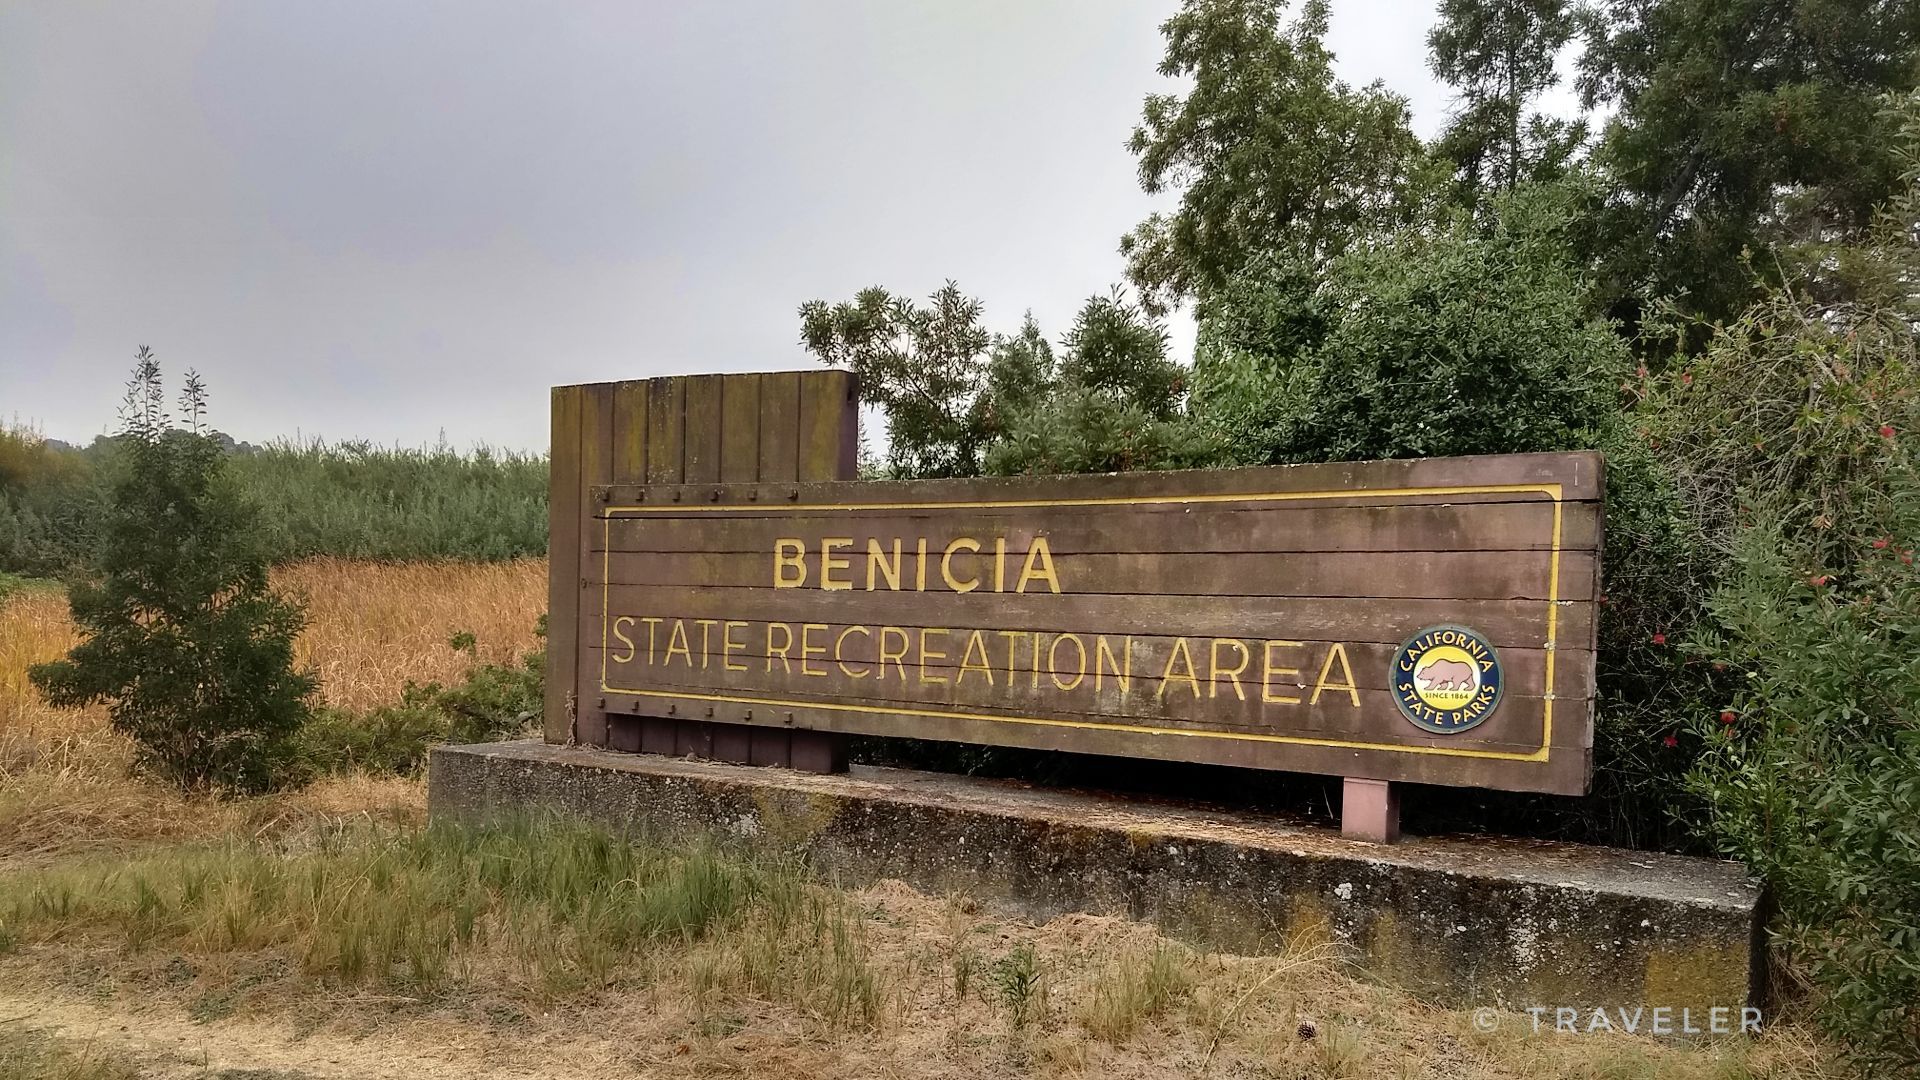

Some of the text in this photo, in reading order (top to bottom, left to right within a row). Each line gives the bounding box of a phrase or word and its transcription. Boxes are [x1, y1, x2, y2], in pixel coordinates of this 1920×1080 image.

[773, 537, 1061, 594] BENICIA
[611, 616, 1361, 707] STATE RECREATION AREA
[1400, 631, 1494, 673] CALIFORNIA
[1398, 682, 1495, 725] STATE PARKS
